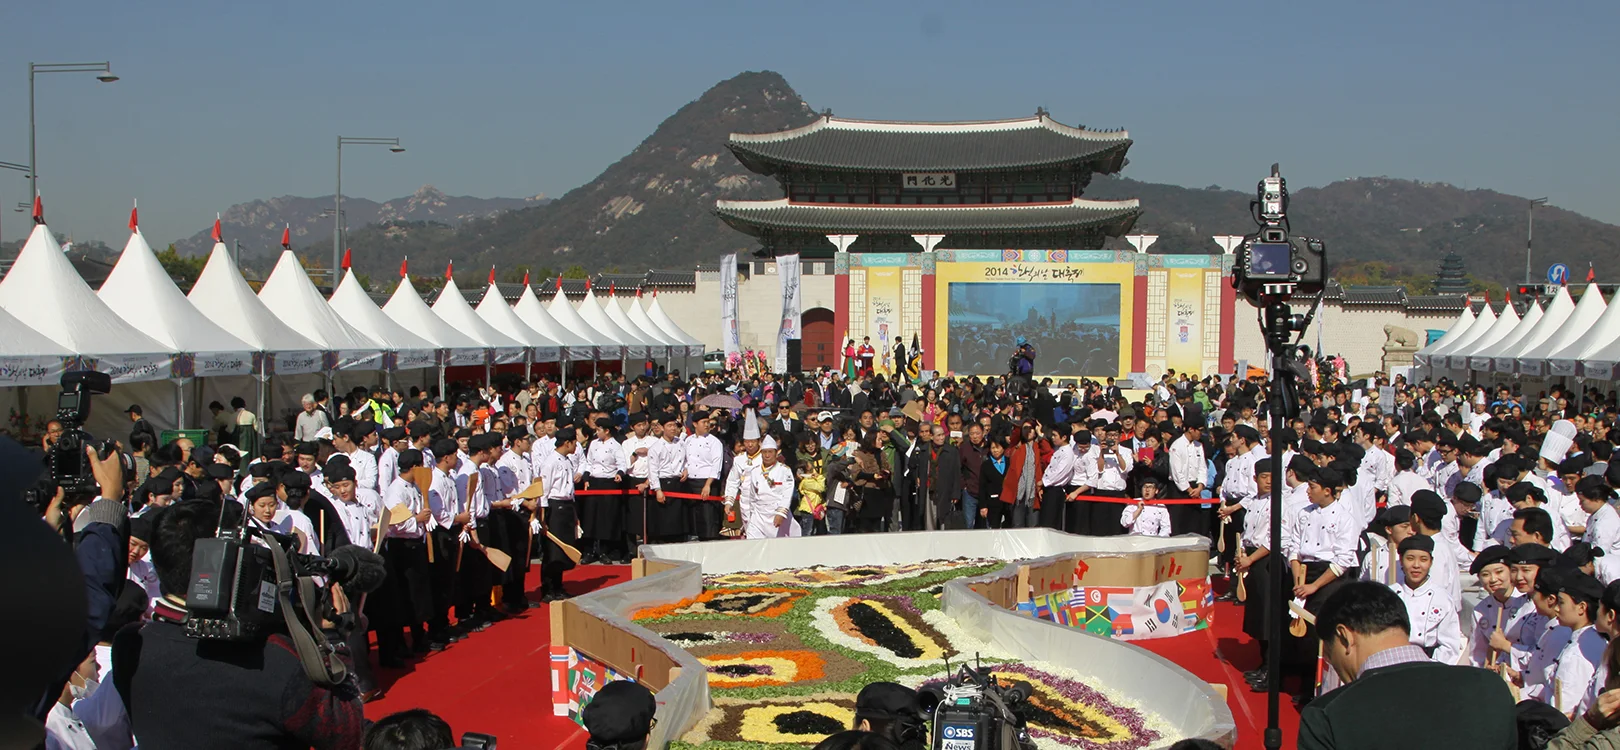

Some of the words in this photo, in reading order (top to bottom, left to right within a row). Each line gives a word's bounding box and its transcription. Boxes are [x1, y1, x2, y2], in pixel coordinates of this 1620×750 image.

[985, 267, 1008, 276] 2014
[1051, 265, 1084, 283] 대축제
[956, 729, 973, 737] SBS
